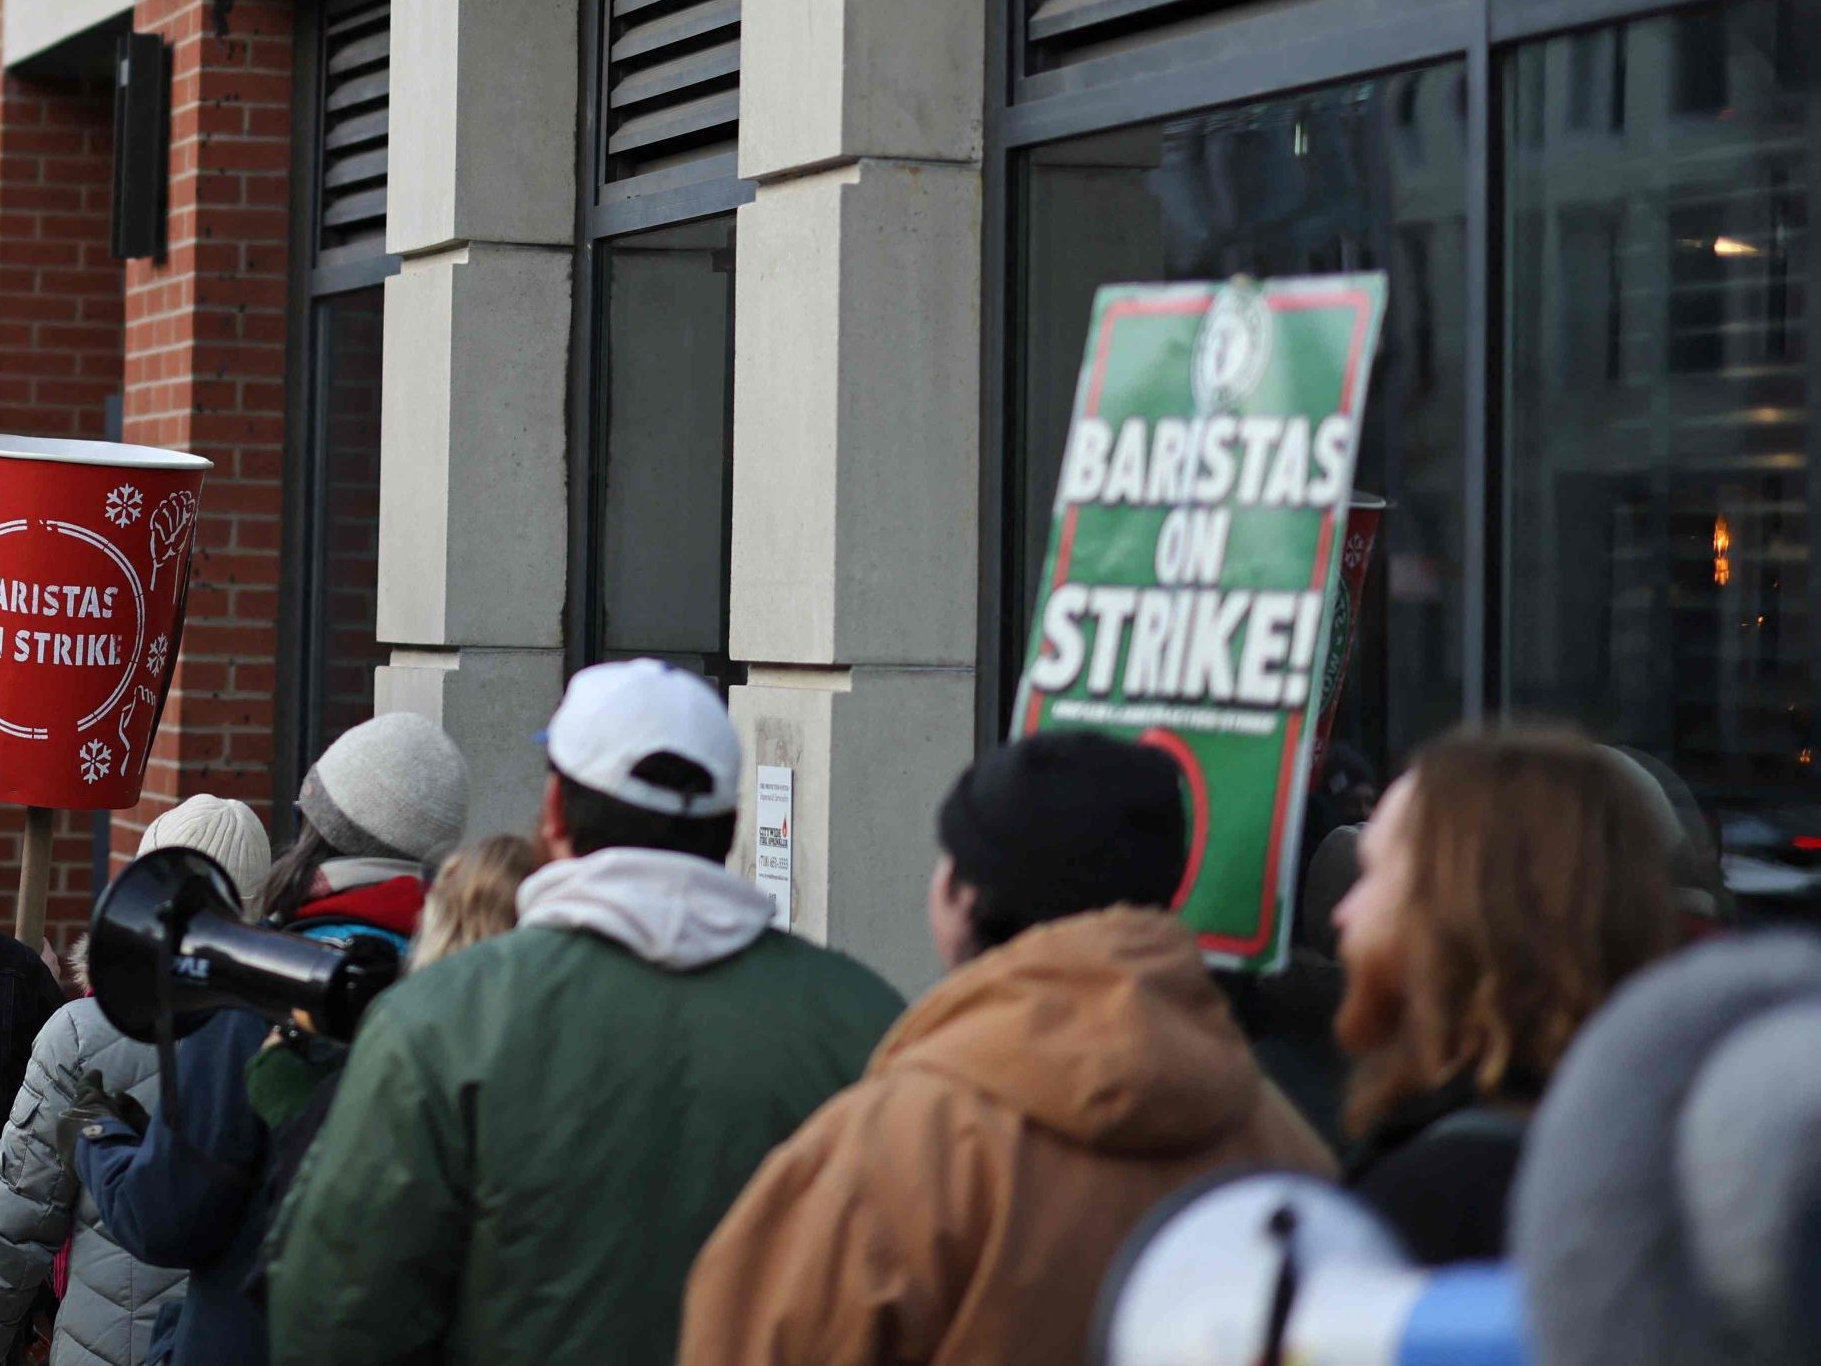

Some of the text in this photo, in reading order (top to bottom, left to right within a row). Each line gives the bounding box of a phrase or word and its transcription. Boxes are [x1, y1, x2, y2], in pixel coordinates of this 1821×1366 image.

[1062, 415, 1350, 506] BARISTAS
[1154, 506, 1229, 585] ON
[13, 629, 123, 667] STRIKE
[1030, 584, 1322, 707] STRIKE!
